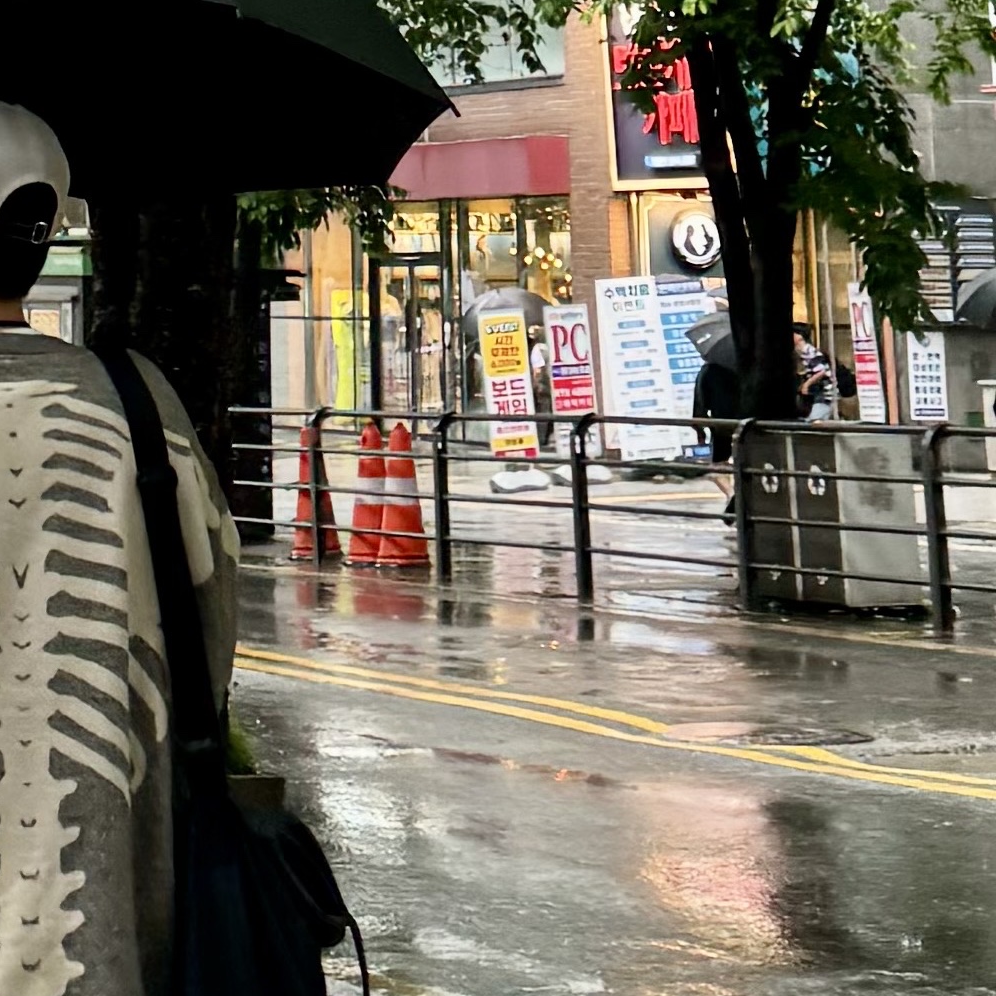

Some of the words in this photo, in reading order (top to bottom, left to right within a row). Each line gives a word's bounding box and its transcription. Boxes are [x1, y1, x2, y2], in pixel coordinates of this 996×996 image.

[550, 324, 589, 363] PC
[492, 378, 526, 398] 보드
[493, 398, 528, 416] 게임
